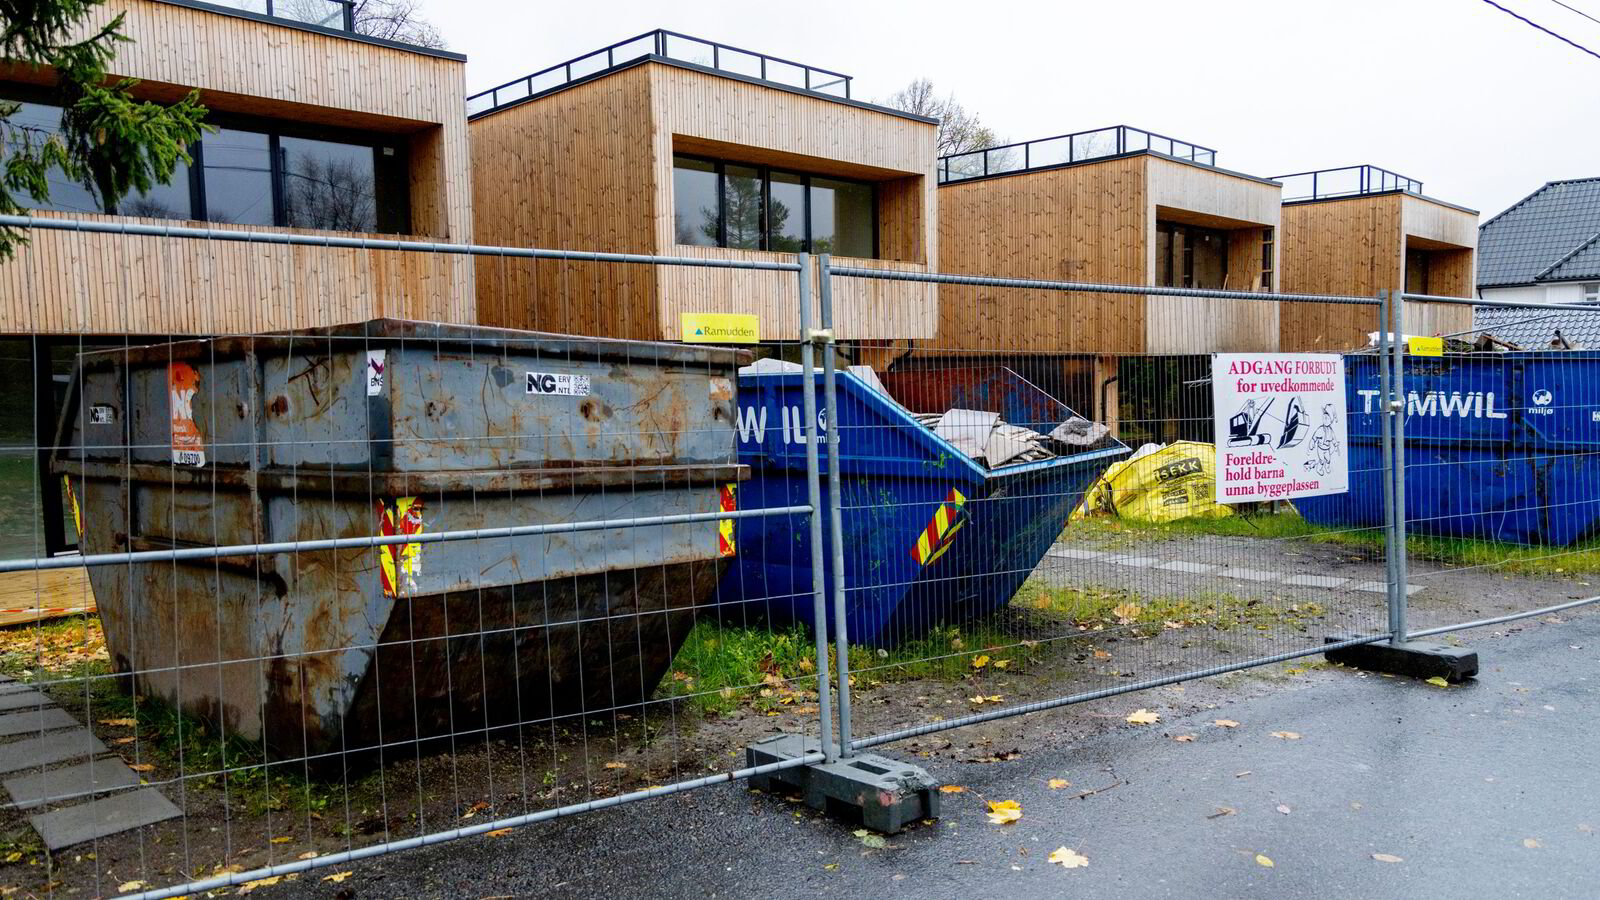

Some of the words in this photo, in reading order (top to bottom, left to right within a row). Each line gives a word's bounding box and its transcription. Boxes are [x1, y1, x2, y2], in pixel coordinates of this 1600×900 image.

[704, 326, 755, 337] Ramudden
[1228, 360, 1293, 375] ADGANG
[1295, 361, 1337, 375] FORBUDT
[527, 374, 556, 393] NG
[1236, 378, 1257, 393] for
[1260, 378, 1335, 393] uvedkommende
[1356, 389, 1508, 419] TMWIL
[1528, 406, 1554, 417] miljø
[1225, 451, 1277, 466] Foreldre-
[1225, 467, 1251, 481] hold
[1254, 466, 1285, 480] barna
[1225, 485, 1255, 496] unna
[1257, 478, 1320, 497] byggeplassen
